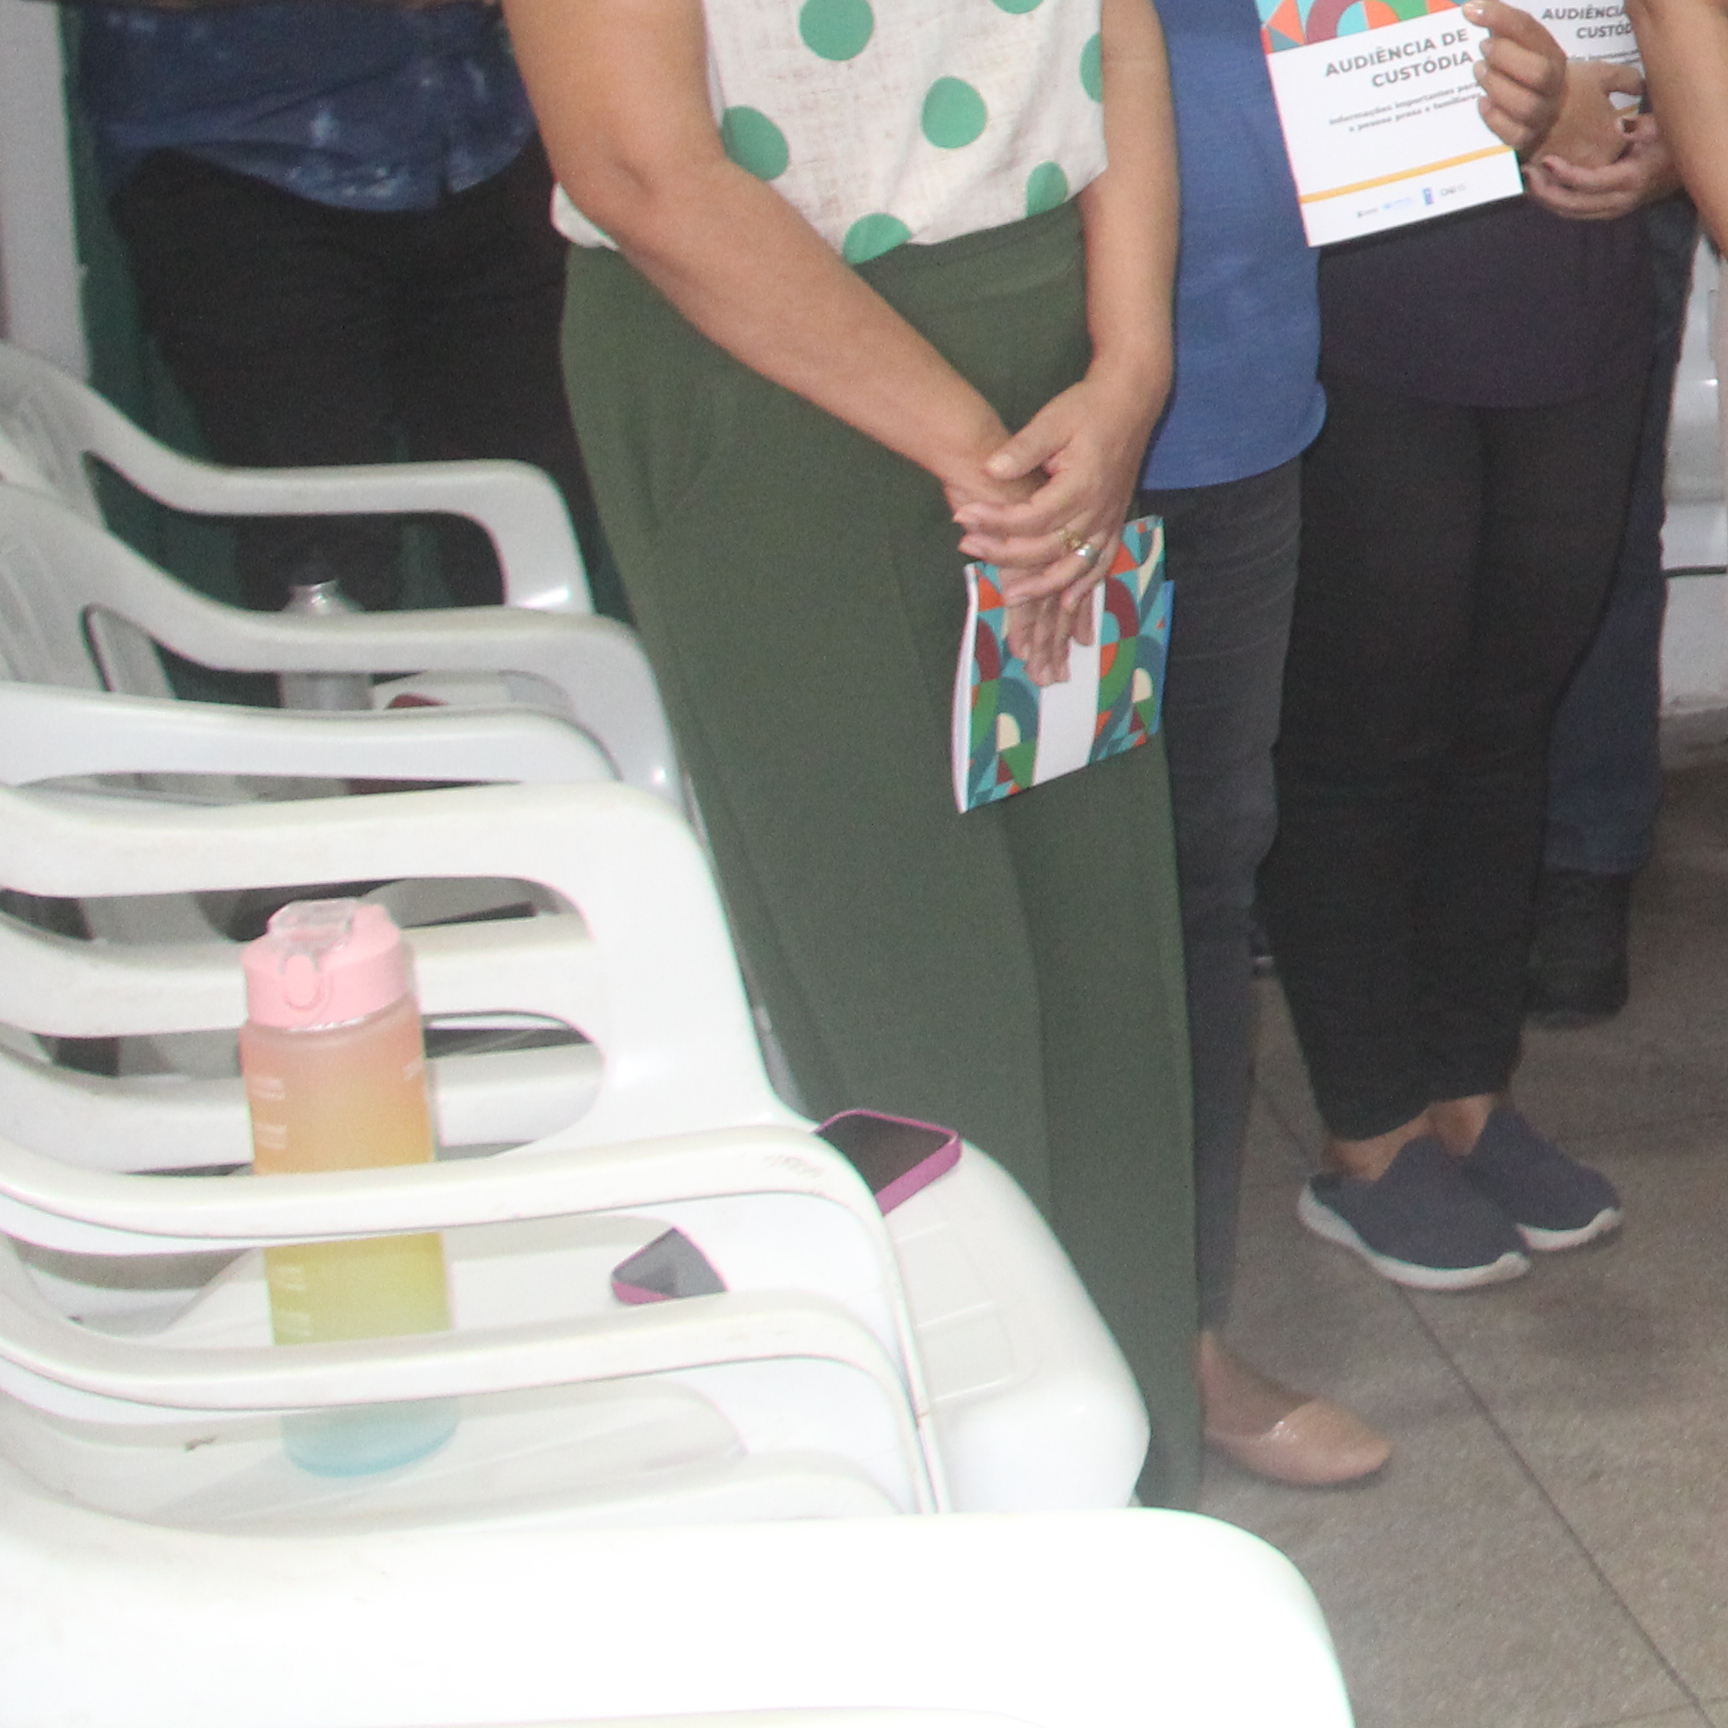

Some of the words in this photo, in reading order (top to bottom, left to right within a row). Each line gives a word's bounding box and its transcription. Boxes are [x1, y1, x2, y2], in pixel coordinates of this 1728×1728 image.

[1576, 20, 1632, 40] CUSTÓD
[1324, 38, 1435, 78] AUDIÊNCIA
[1442, 27, 1470, 49] DE
[1371, 50, 1475, 88] CUSTÓDIA
